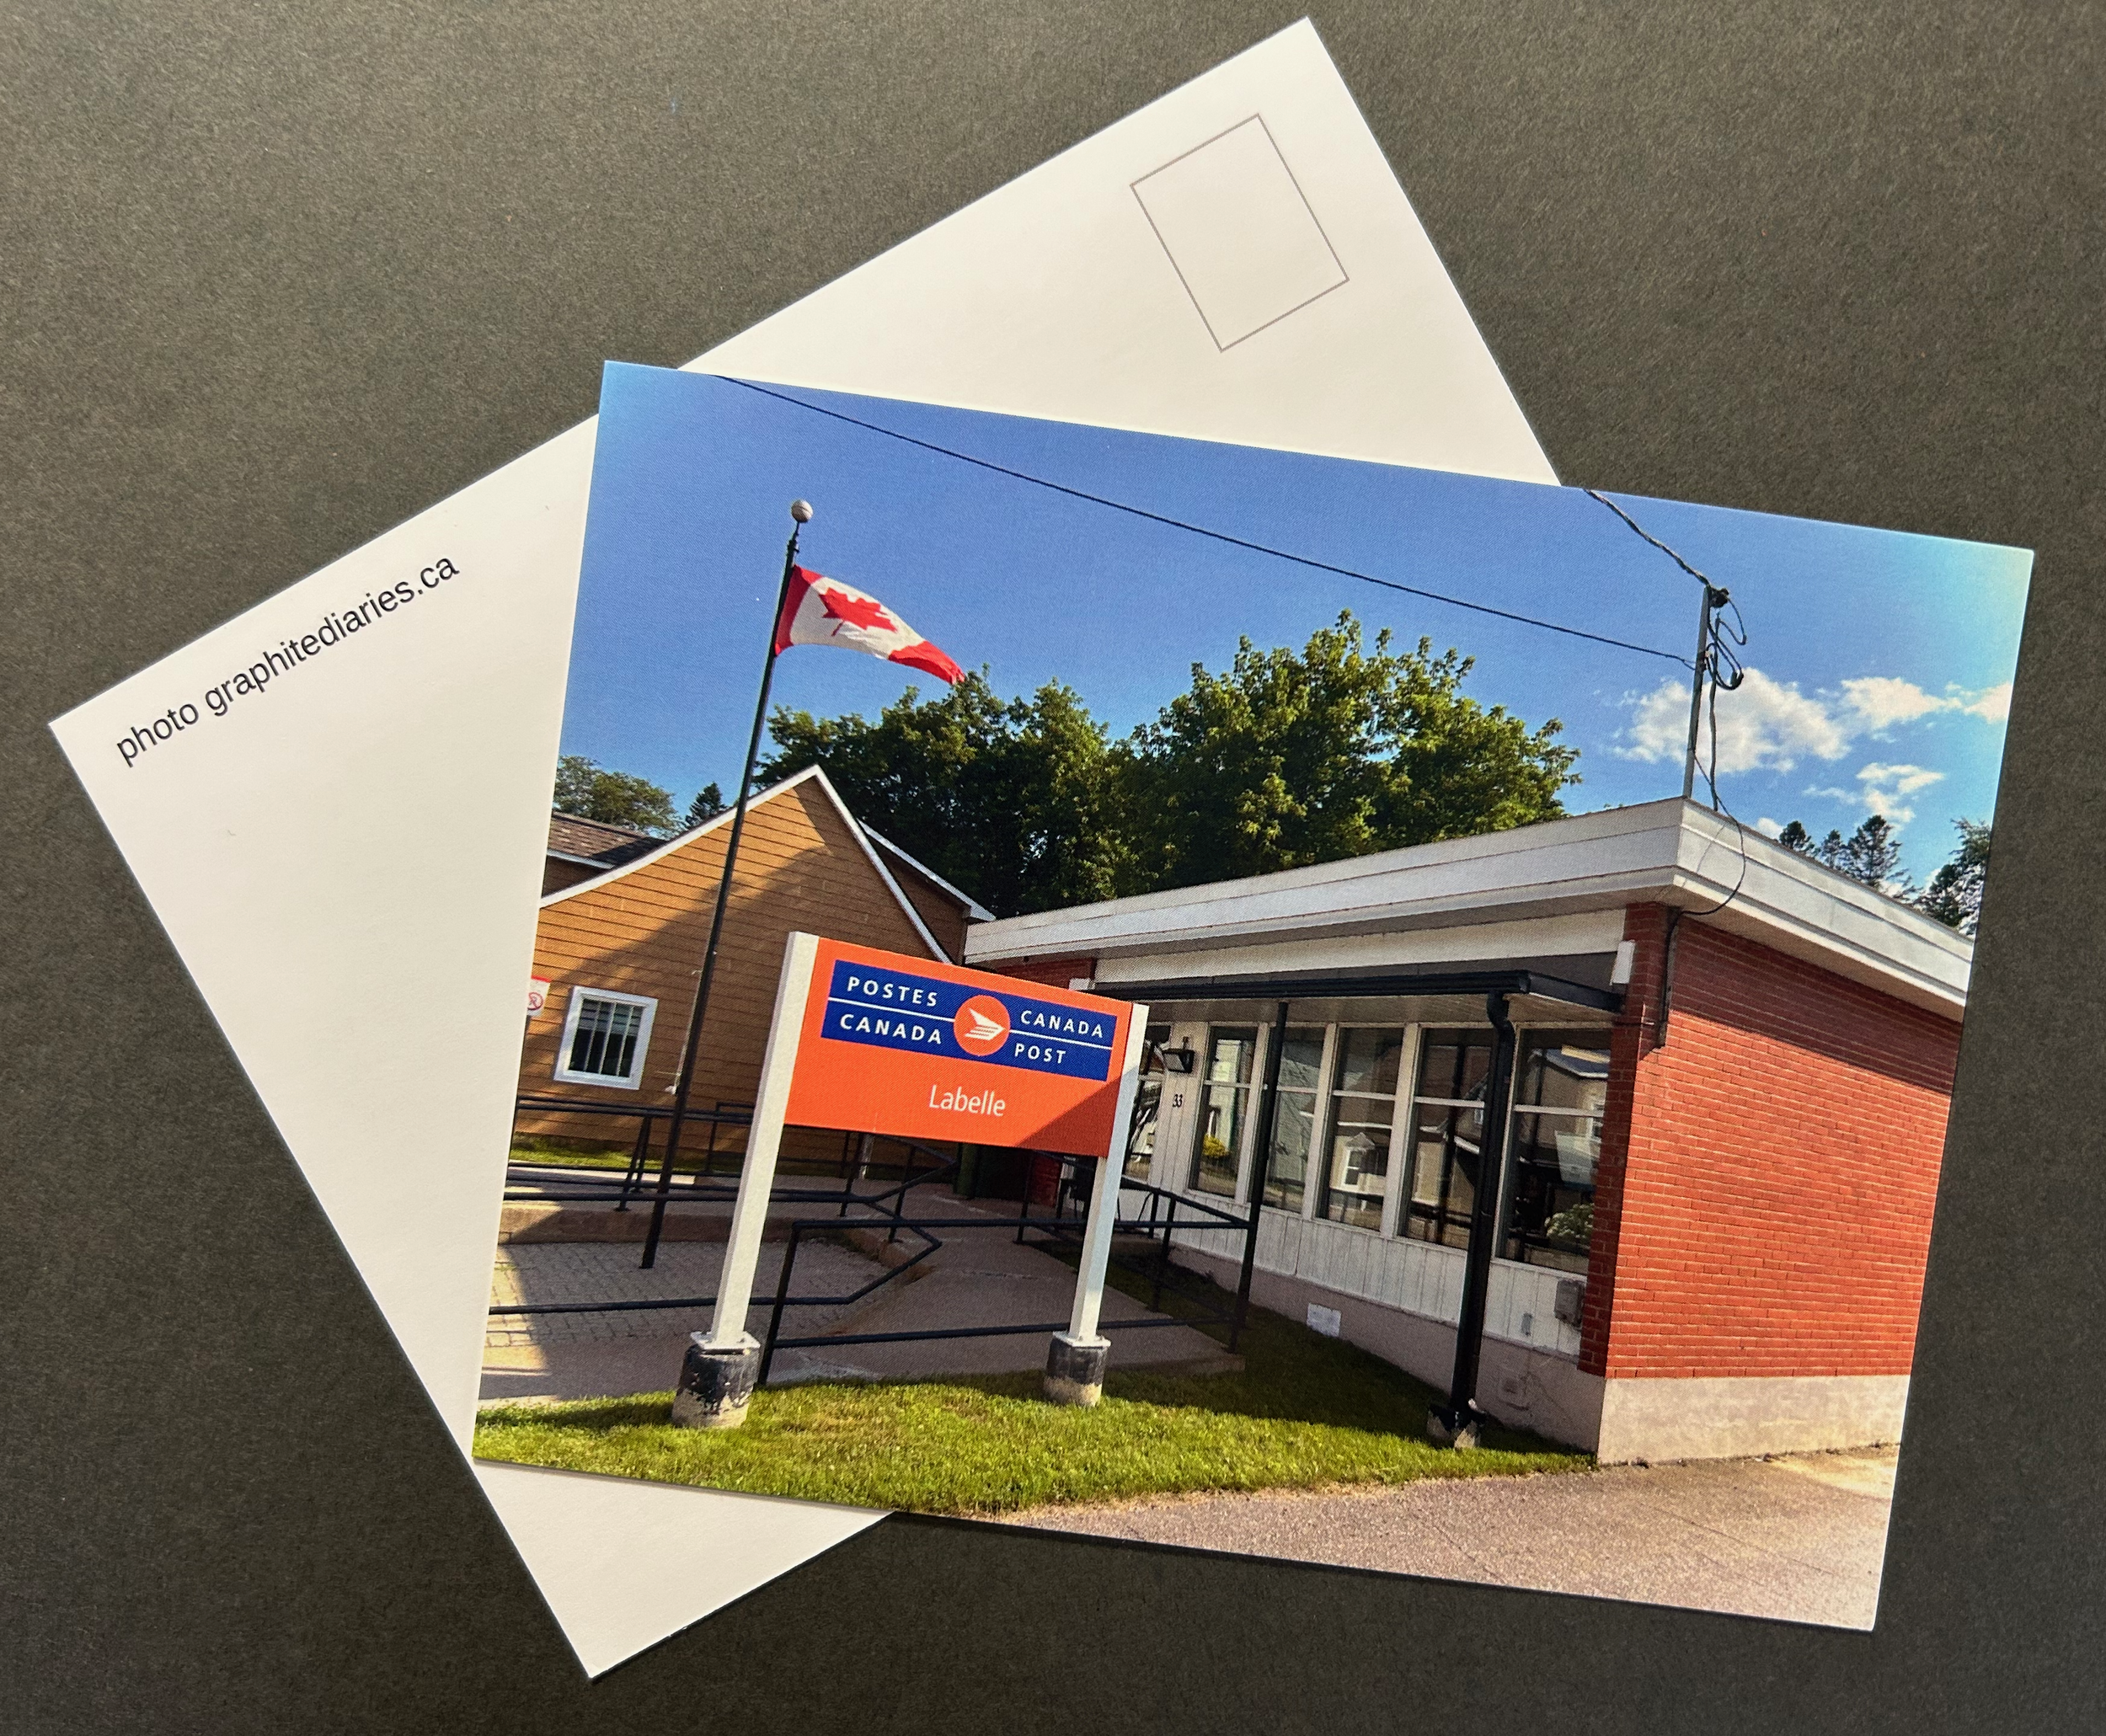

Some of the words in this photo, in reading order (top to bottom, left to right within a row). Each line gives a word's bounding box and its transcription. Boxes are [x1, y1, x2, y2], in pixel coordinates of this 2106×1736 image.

[116, 702, 200, 768] photo
[205, 557, 460, 717] graphitediaries.ca
[847, 976, 938, 1006] POSTES
[840, 1014, 942, 1044] CANADA
[1020, 1010, 1104, 1038] CANADA
[1014, 1043, 1066, 1064] POST
[928, 1085, 1006, 1117] Labelle
[1172, 1093, 1184, 1108] 33
